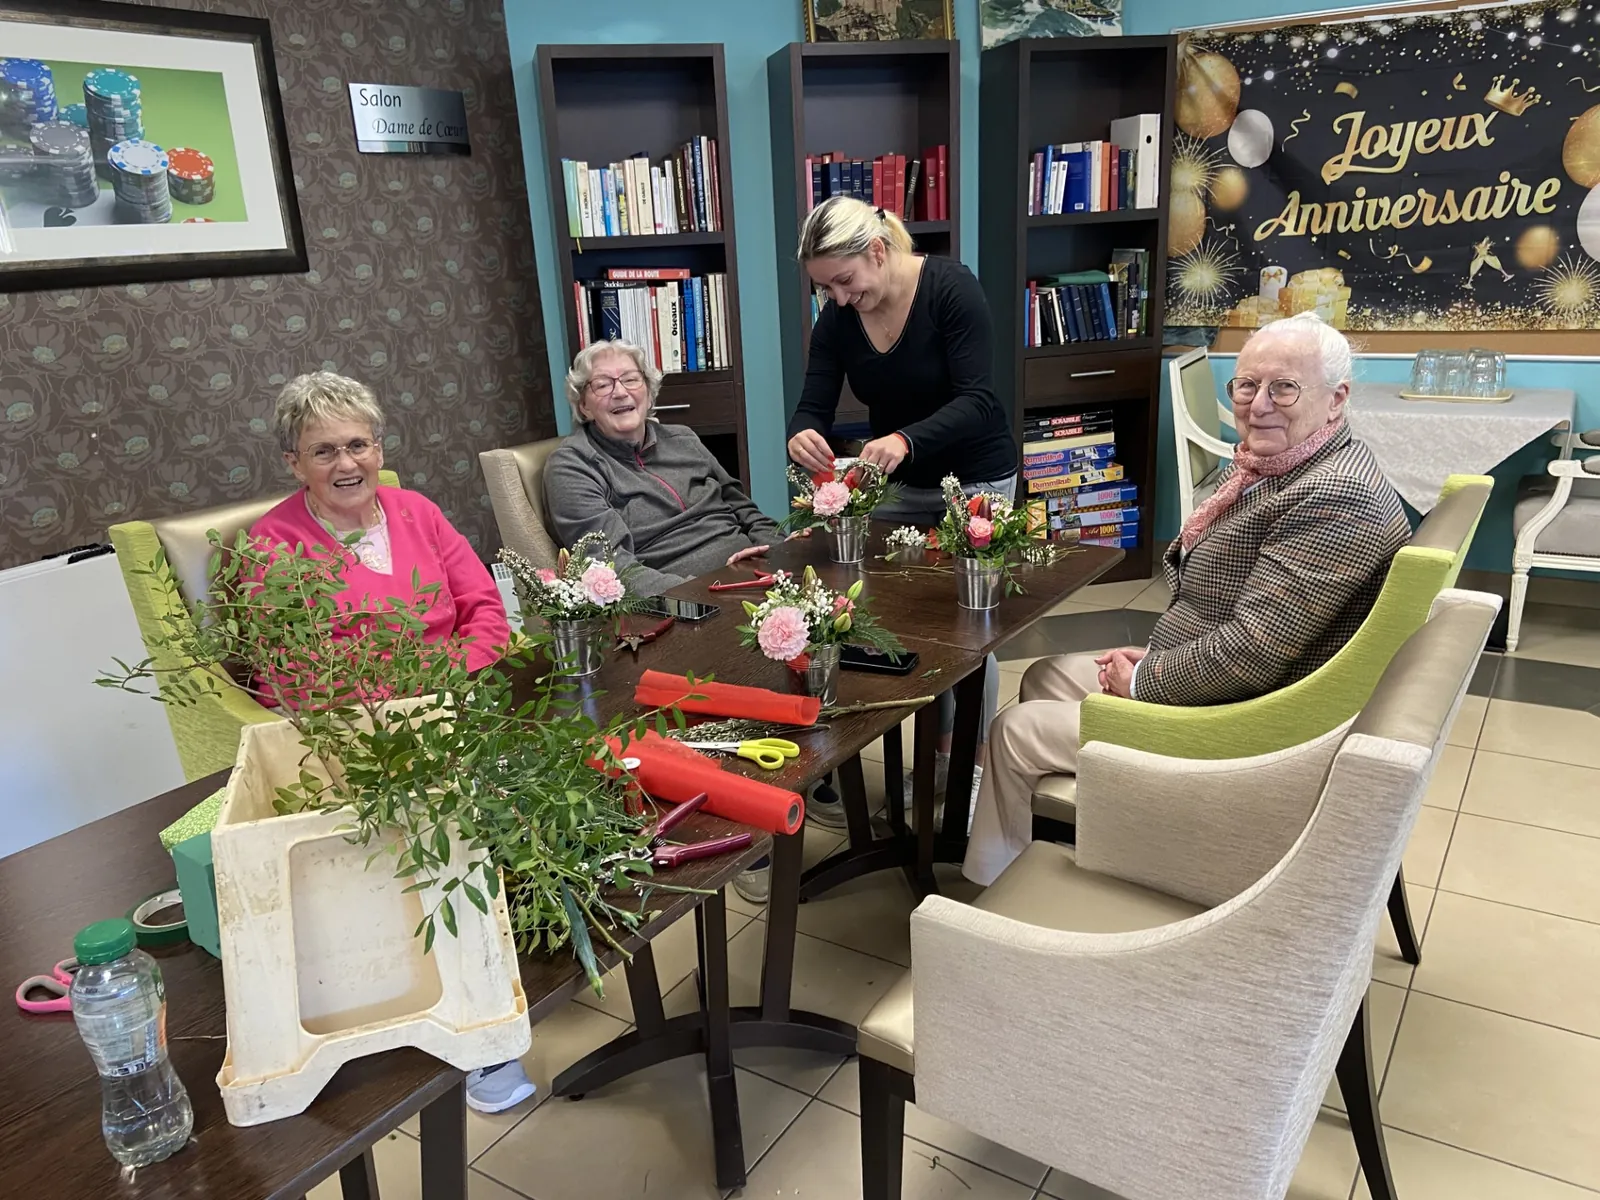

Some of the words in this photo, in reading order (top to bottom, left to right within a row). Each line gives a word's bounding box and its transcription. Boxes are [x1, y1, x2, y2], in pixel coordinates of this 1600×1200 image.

[359, 88, 402, 108] Salon
[372, 117, 415, 135] Dame
[418, 117, 432, 135] de
[435, 120, 465, 138] Cœur
[1321, 110, 1499, 185] Joyeux
[1253, 170, 1562, 242] Anniversaire
[612, 270, 628, 278] GUIDE
[628, 270, 636, 278] DE
[636, 270, 643, 278] LA
[644, 270, 659, 278] ROUTE
[670, 301, 678, 336] Oiseaux
[1051, 415, 1081, 426] SCRABBLE
[1054, 426, 1083, 437] SCRABBLE
[1023, 452, 1064, 466] Rummikub
[1023, 465, 1063, 478] Rummikub
[1032, 478, 1072, 490] Rummikub
[1097, 490, 1113, 502] 1000
[1099, 525, 1115, 534] 1000
